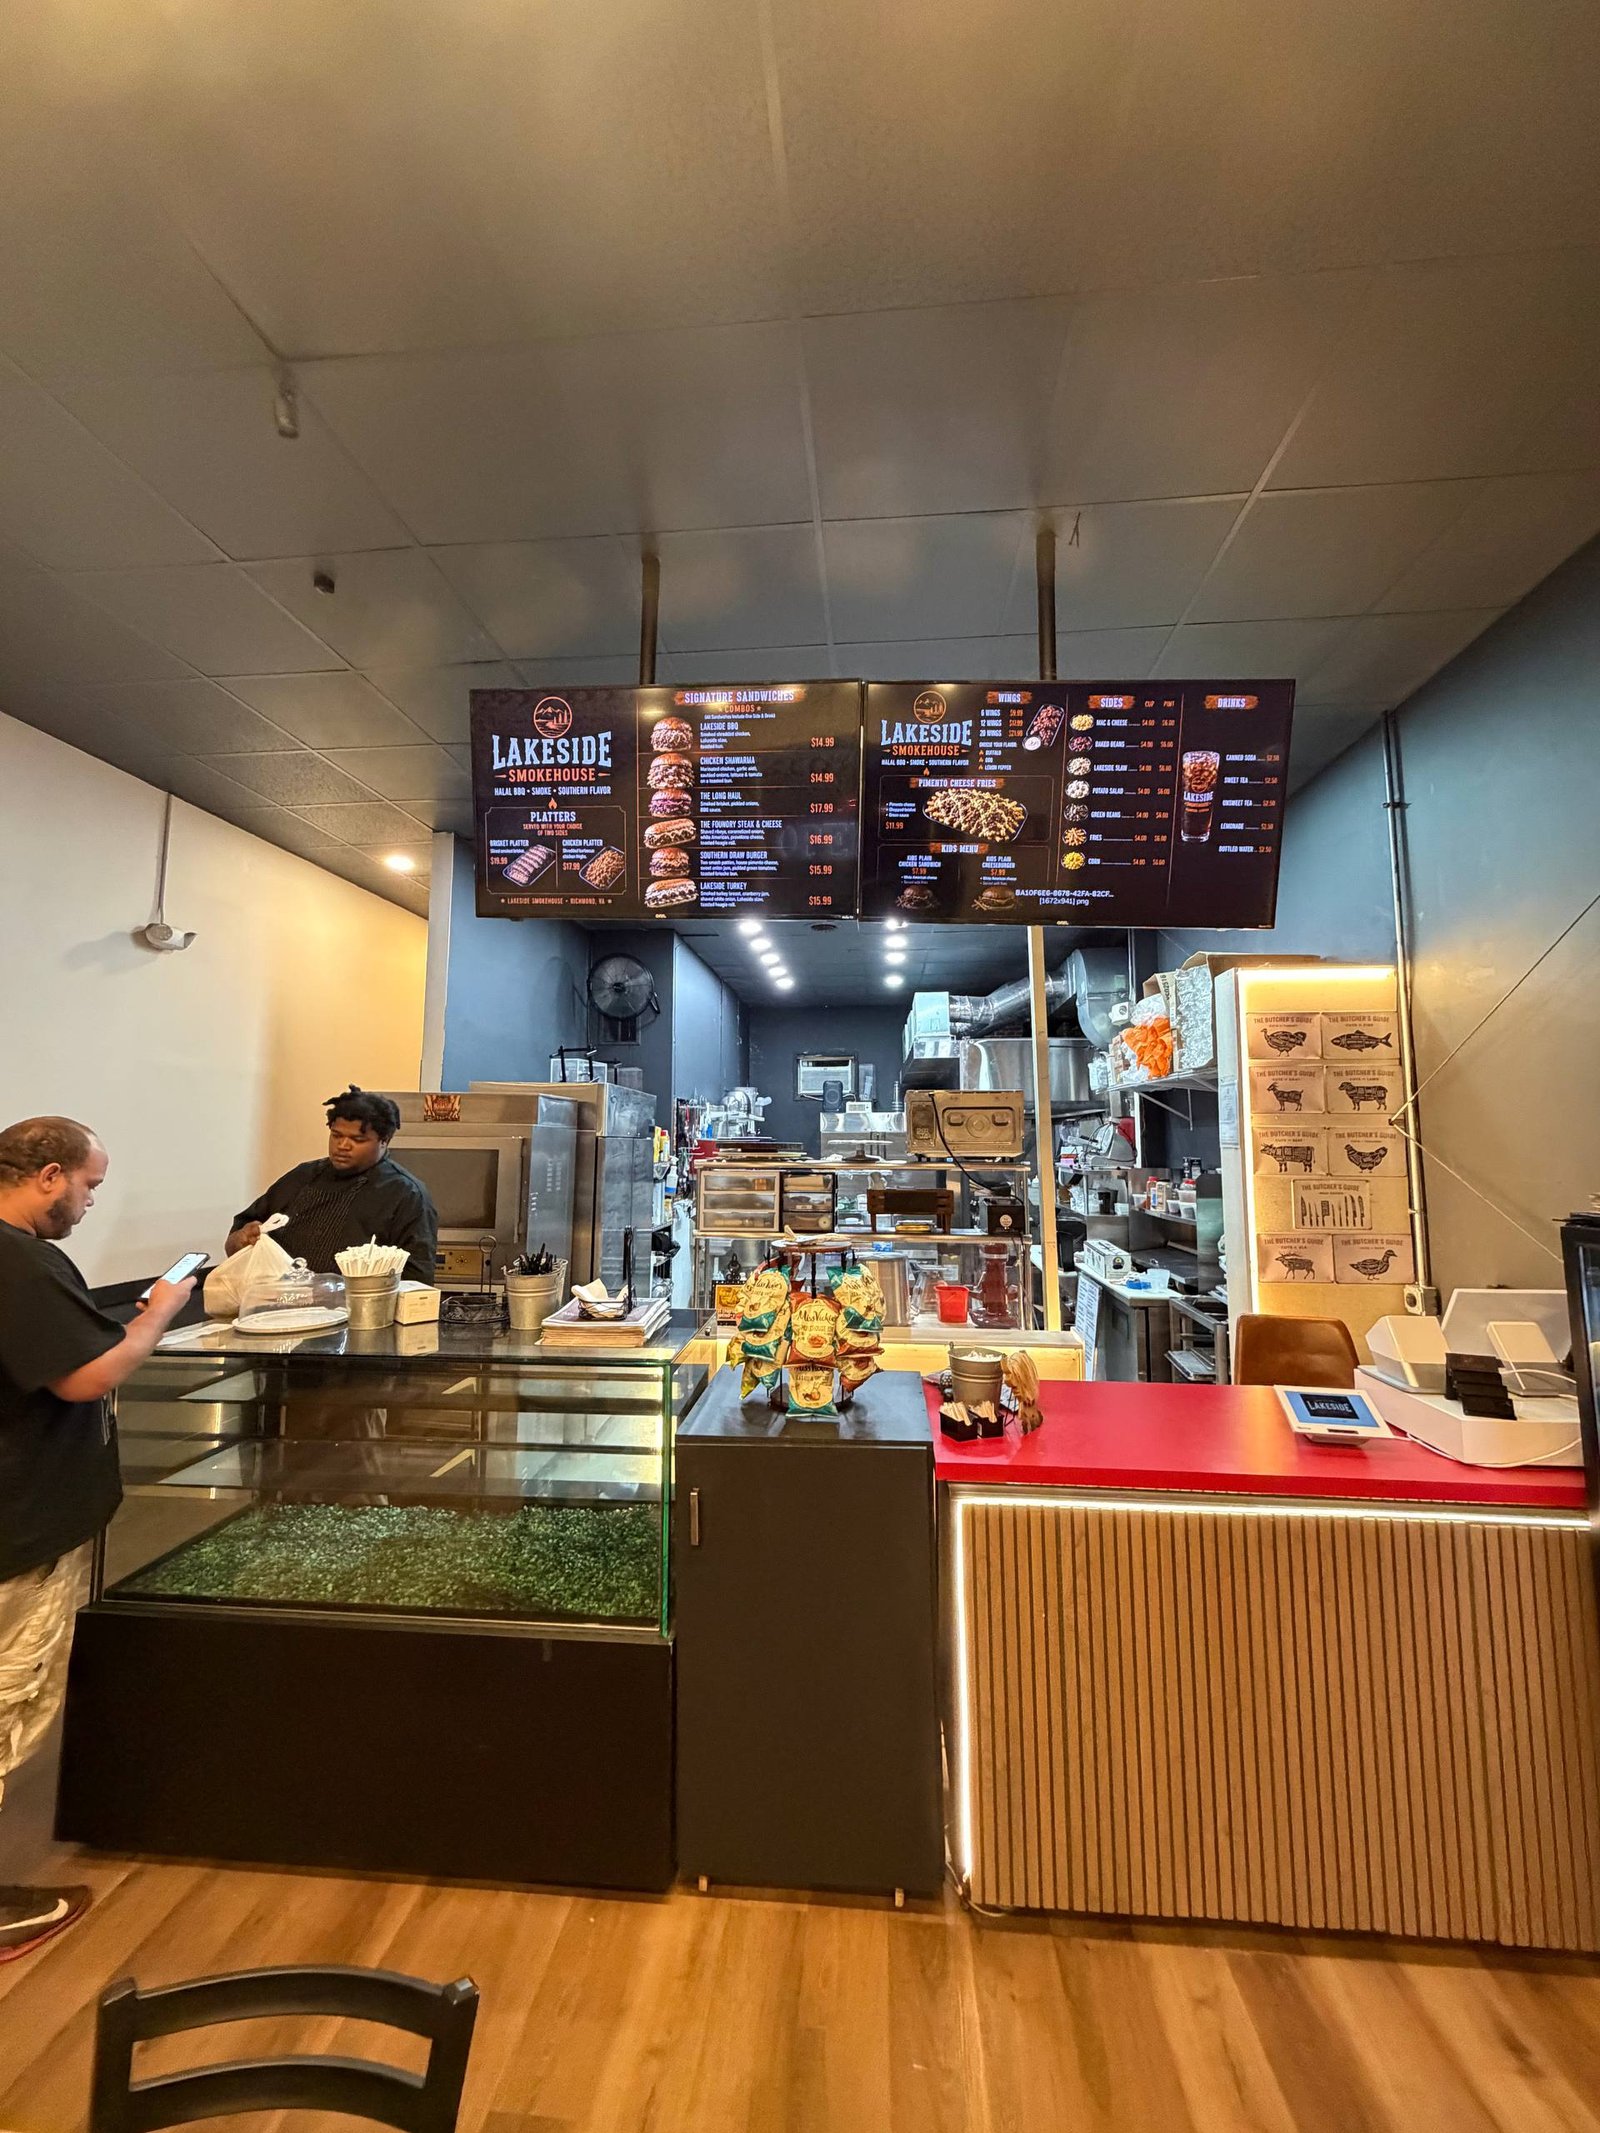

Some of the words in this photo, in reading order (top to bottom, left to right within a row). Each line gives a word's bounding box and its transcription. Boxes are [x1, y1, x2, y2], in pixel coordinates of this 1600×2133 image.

[684, 692, 733, 704] SIGNATURE
[736, 690, 794, 702] SANDWICHES
[998, 694, 1021, 703] WINGS
[724, 704, 756, 712] COMBOS
[1100, 698, 1123, 708] SIDES
[1218, 698, 1246, 708] DRINKS
[700, 722, 726, 730] LAKESIDE
[727, 722, 739, 730] BBQ
[880, 720, 973, 746] LAKESIDE
[811, 737, 834, 747] $14.99
[492, 731, 612, 770] LAKESIDE
[892, 745, 960, 756] SMOKEHOUSE
[700, 756, 724, 765] CHICKEN
[724, 756, 755, 764] SHAWARMA
[508, 768, 596, 782] SMOKEHOUSE
[810, 773, 834, 783] $14.99
[918, 778, 948, 788] PIMENTO
[950, 778, 974, 788] CHEESE
[977, 778, 996, 788] FRIES
[494, 787, 512, 796] HALAL
[513, 787, 526, 796] BBQ
[532, 787, 552, 796] SMOKE
[558, 786, 588, 795] SOUTHERN
[589, 786, 612, 795] FLAVOR
[701, 792, 710, 800] THE
[712, 792, 726, 800] LONG
[728, 792, 742, 800] HAUL
[1184, 791, 1214, 801] LAKESIDE
[810, 803, 833, 813] $17.99
[530, 811, 576, 822] PLATTERS
[701, 820, 710, 828] THE
[712, 820, 736, 828] FOUNDRY
[738, 820, 754, 828] STEAK
[756, 820, 760, 828] &
[762, 820, 782, 828] CHEESE
[809, 835, 833, 845] $16.99
[941, 844, 957, 853] KIDS
[960, 844, 979, 853] MENU
[700, 851, 728, 859] SOUTHERN
[729, 851, 745, 859] DRAW
[746, 851, 768, 859] BURGER
[562, 862, 580, 871] $17.99
[809, 865, 833, 875] $15.99
[700, 882, 725, 890] LAKESIDE
[727, 882, 747, 890] TURKEY
[808, 896, 832, 906] $15.99
[1265, 1016, 1295, 1024] BUTCHER'S
[1353, 1238, 1384, 1246] BUTCHER'S
[1307, 1401, 1352, 1412] LAKESIDE
